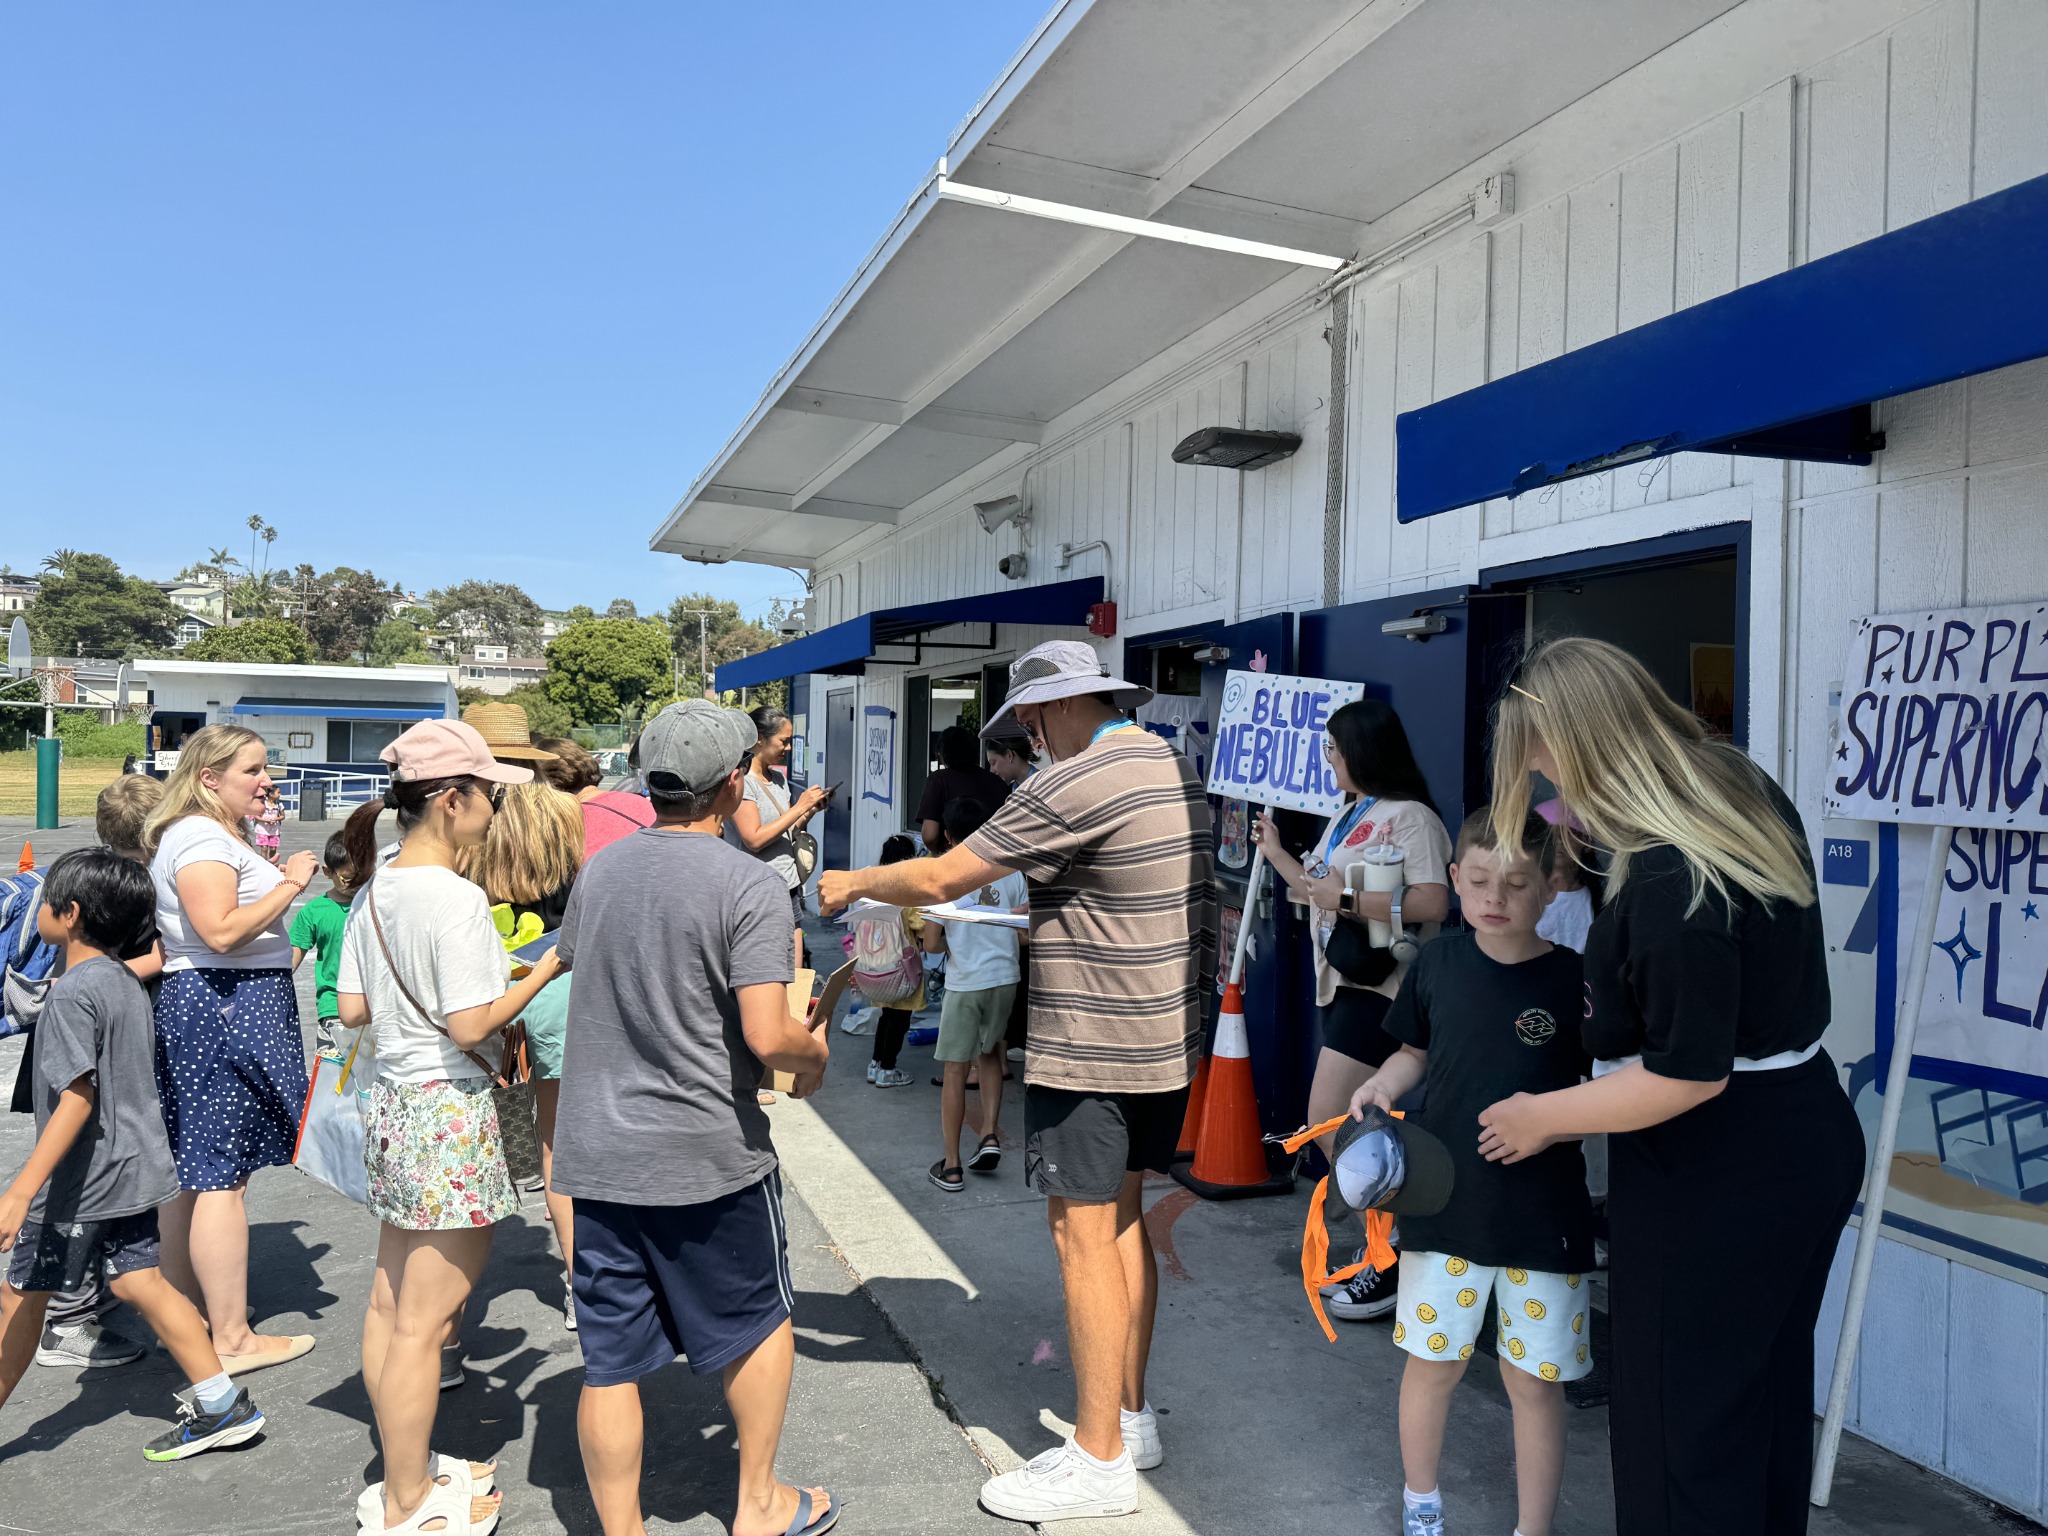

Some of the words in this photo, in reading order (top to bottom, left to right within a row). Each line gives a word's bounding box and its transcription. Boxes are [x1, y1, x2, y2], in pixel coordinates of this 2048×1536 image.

[1252, 688, 1331, 732] BLUE
[1836, 691, 2048, 815] SUPERNO
[1828, 844, 1852, 858] A18
